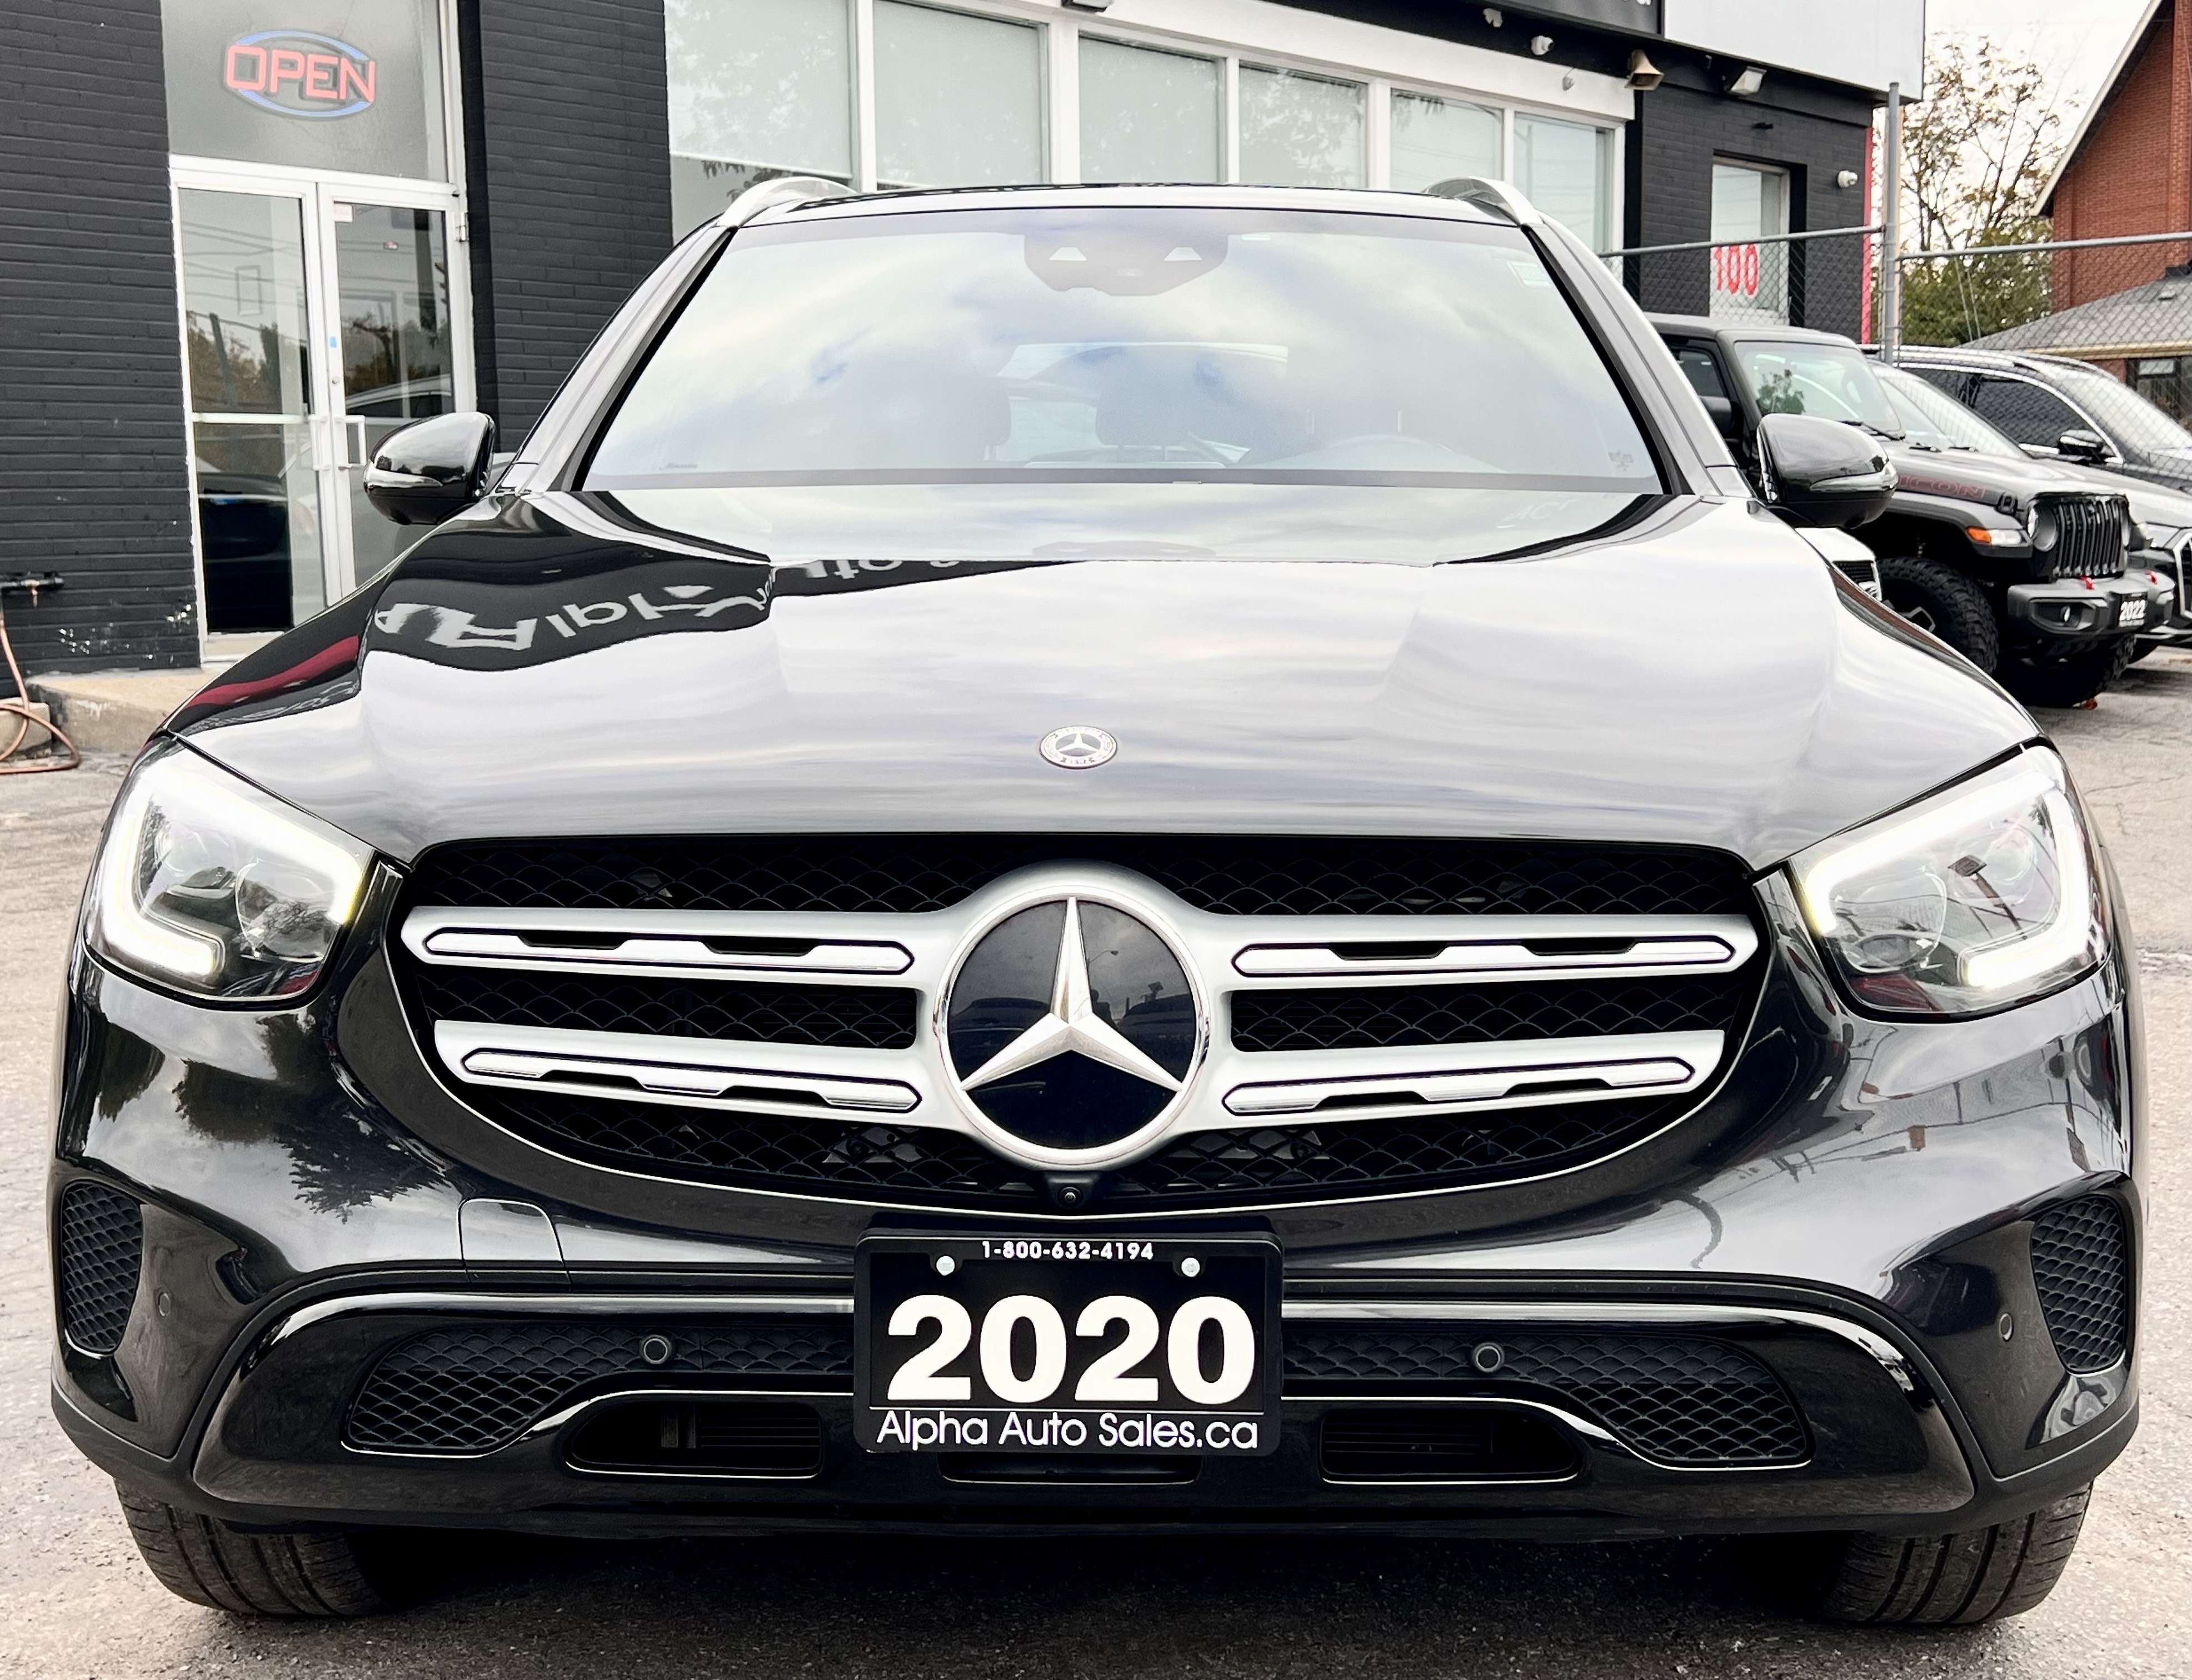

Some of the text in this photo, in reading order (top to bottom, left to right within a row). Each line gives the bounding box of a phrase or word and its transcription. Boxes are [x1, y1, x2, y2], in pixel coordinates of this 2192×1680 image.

[226, 44, 376, 103] OPEN
[1714, 243, 1759, 296] 100
[1899, 474, 1986, 499] ICON
[2119, 599, 2146, 621] 2022
[982, 1241, 1154, 1260] 1-800-632-4194
[887, 1294, 1255, 1404] 2020
[876, 1410, 1258, 1451] Alpha Auto Sales.ca
